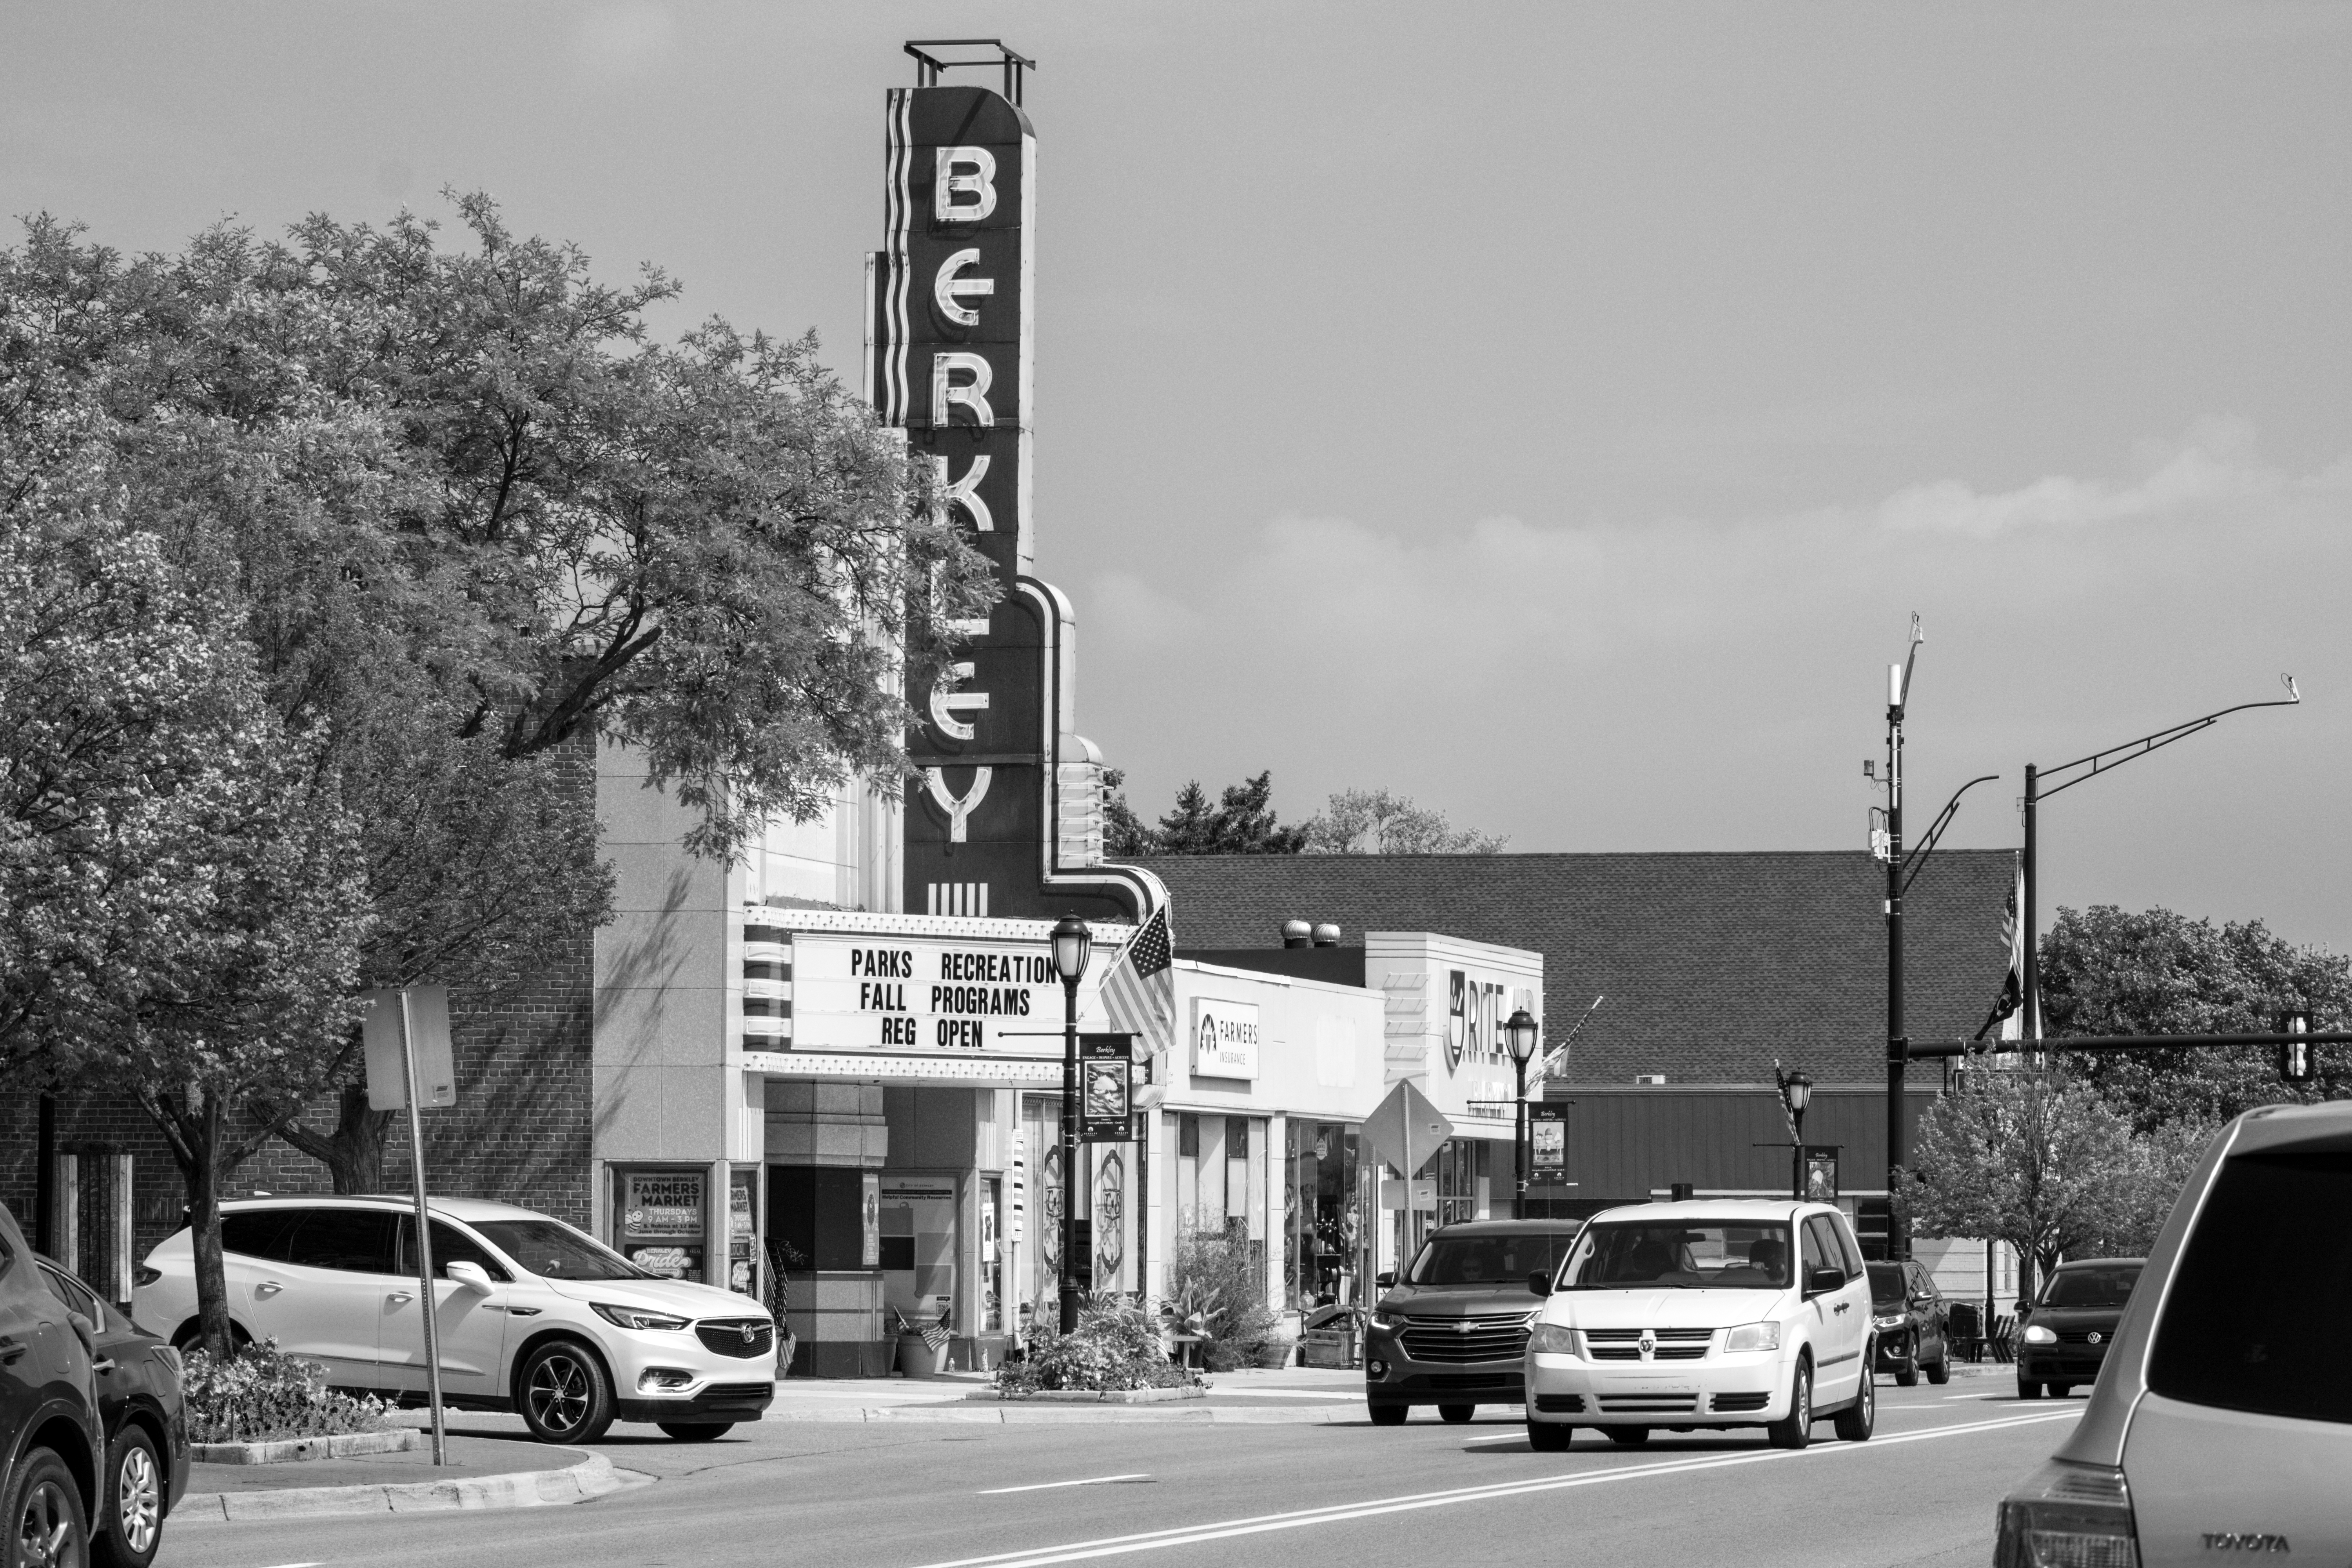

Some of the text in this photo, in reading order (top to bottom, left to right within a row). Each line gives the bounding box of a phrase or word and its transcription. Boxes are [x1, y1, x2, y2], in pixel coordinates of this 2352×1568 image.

[926, 147, 996, 842] BERKLEY
[852, 949, 1056, 984] PARKS RECREATION
[861, 982, 1030, 1016] FALL PROGRAMS
[1468, 980, 1504, 1054] RITE
[882, 1017, 982, 1047] REG OPEN
[1220, 1020, 1257, 1045] FARMERS
[1096, 1045, 1115, 1055] Berkley
[1220, 1051, 1245, 1065] INSURANCE
[633, 1183, 699, 1194] FARMERS
[642, 1195, 699, 1206] MARKET
[633, 1248, 689, 1268] Pride
[2202, 1533, 2290, 1553] TOYOTA
